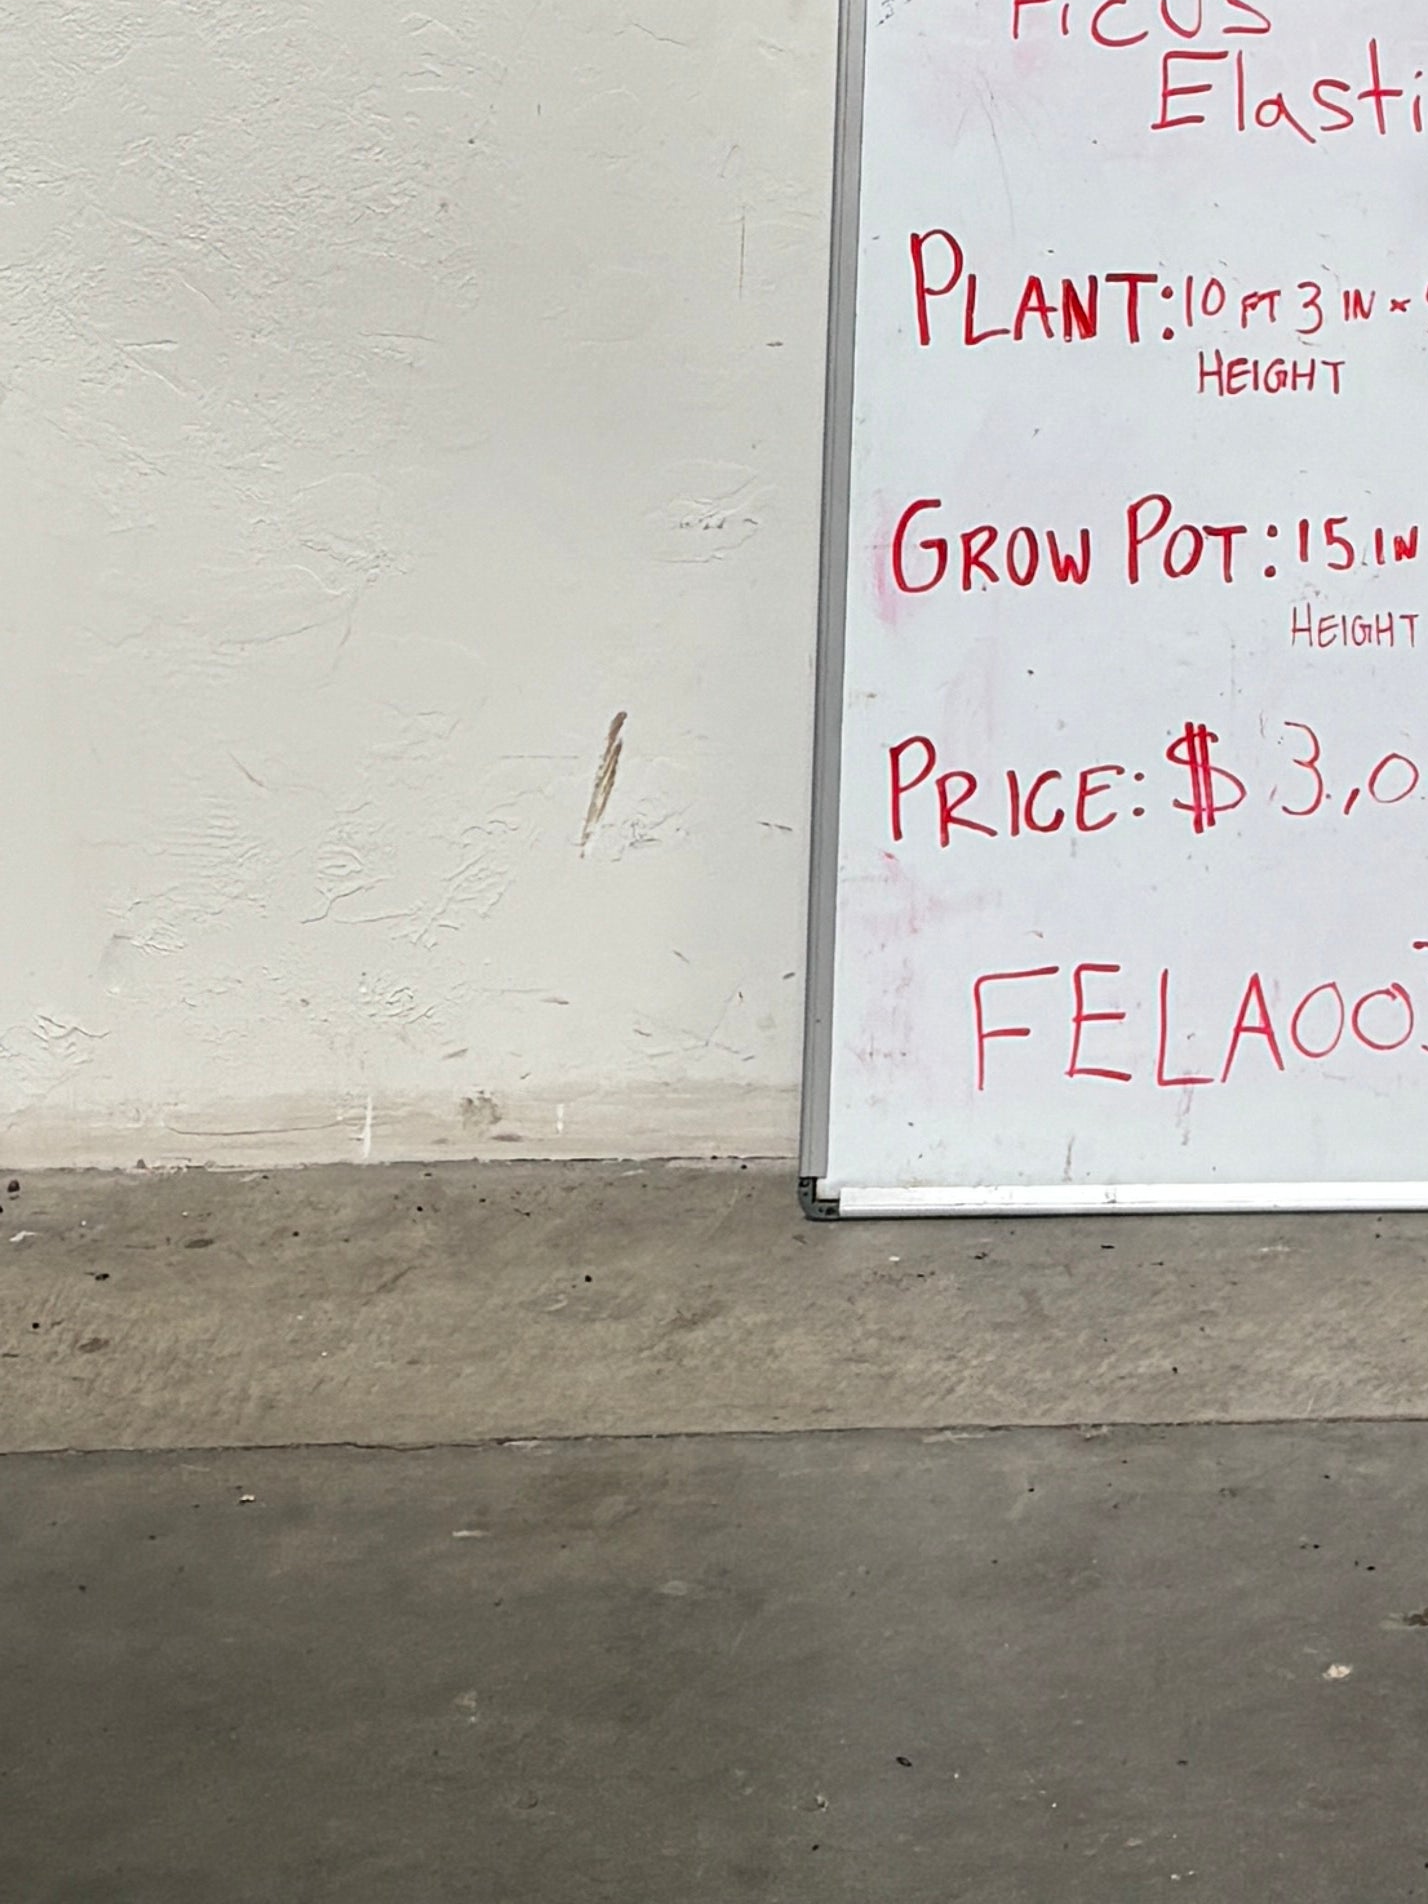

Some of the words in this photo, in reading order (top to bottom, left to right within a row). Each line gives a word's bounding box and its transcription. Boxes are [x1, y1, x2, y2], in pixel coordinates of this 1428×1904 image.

[909, 229, 1174, 347] PLANT:
[1240, 289, 1281, 329] FT
[1298, 281, 1324, 336] 3
[1342, 288, 1376, 321] IN
[1197, 348, 1345, 397] HEIGHT
[889, 498, 1092, 596] GROW
[1125, 494, 1277, 585] POT:
[1297, 517, 1355, 572] 15
[1373, 525, 1420, 567] IN
[1291, 602, 1420, 649] HEIGHT
[888, 735, 1143, 848] PRICE:
